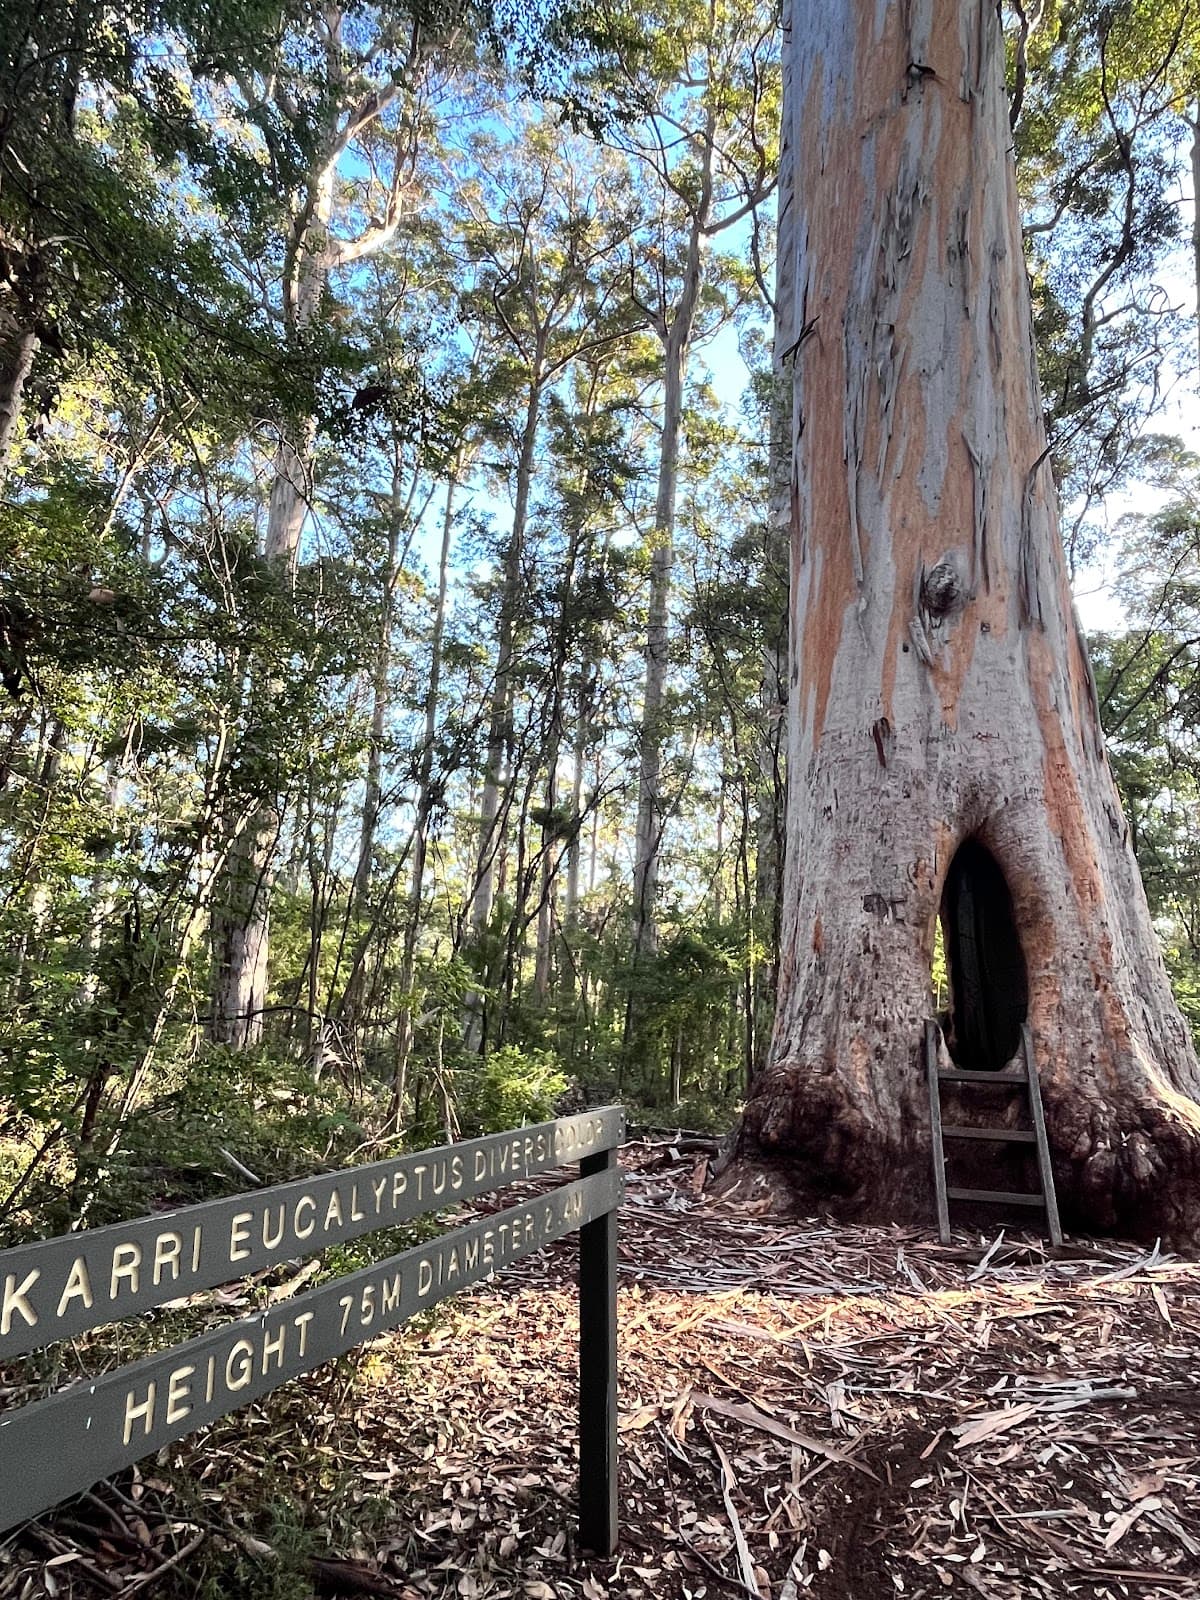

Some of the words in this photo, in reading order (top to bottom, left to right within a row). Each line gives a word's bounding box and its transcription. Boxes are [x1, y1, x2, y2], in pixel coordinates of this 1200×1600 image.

[1, 1226, 202, 1336] KARRI
[230, 1156, 464, 1262] EUCALYPTUS
[474, 1119, 603, 1182] DIVERSICOLOR
[123, 1312, 315, 1446] HEIGHT
[339, 1270, 402, 1338] 75M
[418, 1213, 535, 1297] DIAMETER
